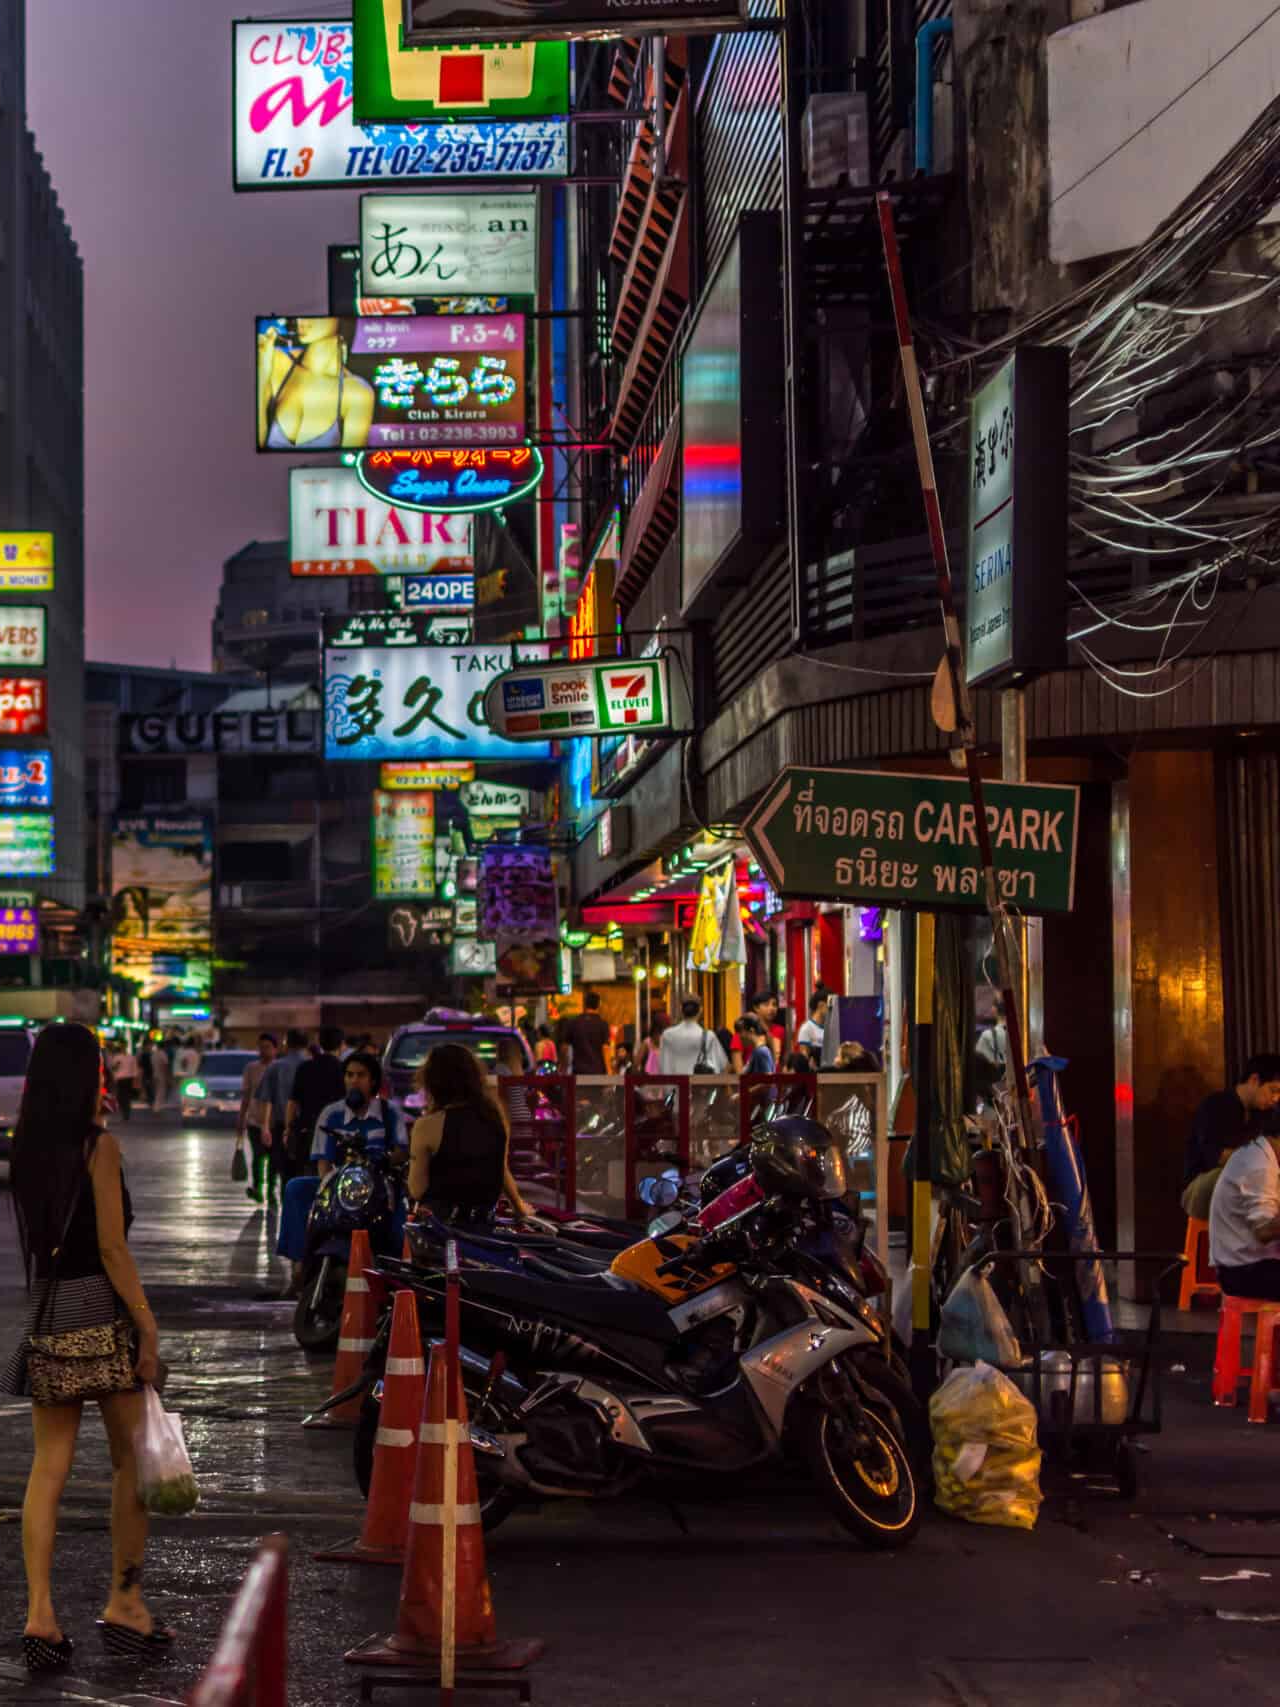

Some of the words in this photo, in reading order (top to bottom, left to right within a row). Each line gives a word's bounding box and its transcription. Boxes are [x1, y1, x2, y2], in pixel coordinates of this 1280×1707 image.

[250, 34, 344, 65] CLUB
[261, 147, 313, 178] FL.3
[344, 147, 384, 176] TEL
[370, 222, 458, 281] あん
[374, 356, 517, 409] きらら
[407, 409, 440, 420] Club
[379, 428, 405, 441] Tel
[315, 506, 474, 546] TIAR
[10, 575, 49, 586] MONEY
[974, 542, 1012, 594] SERINA
[551, 679, 587, 692] BOOK
[551, 691, 590, 704] Smile
[793, 778, 905, 841] ที่จอดรถ
[835, 849, 919, 890] ธนิยะ
[933, 863, 1037, 900] พลซา
